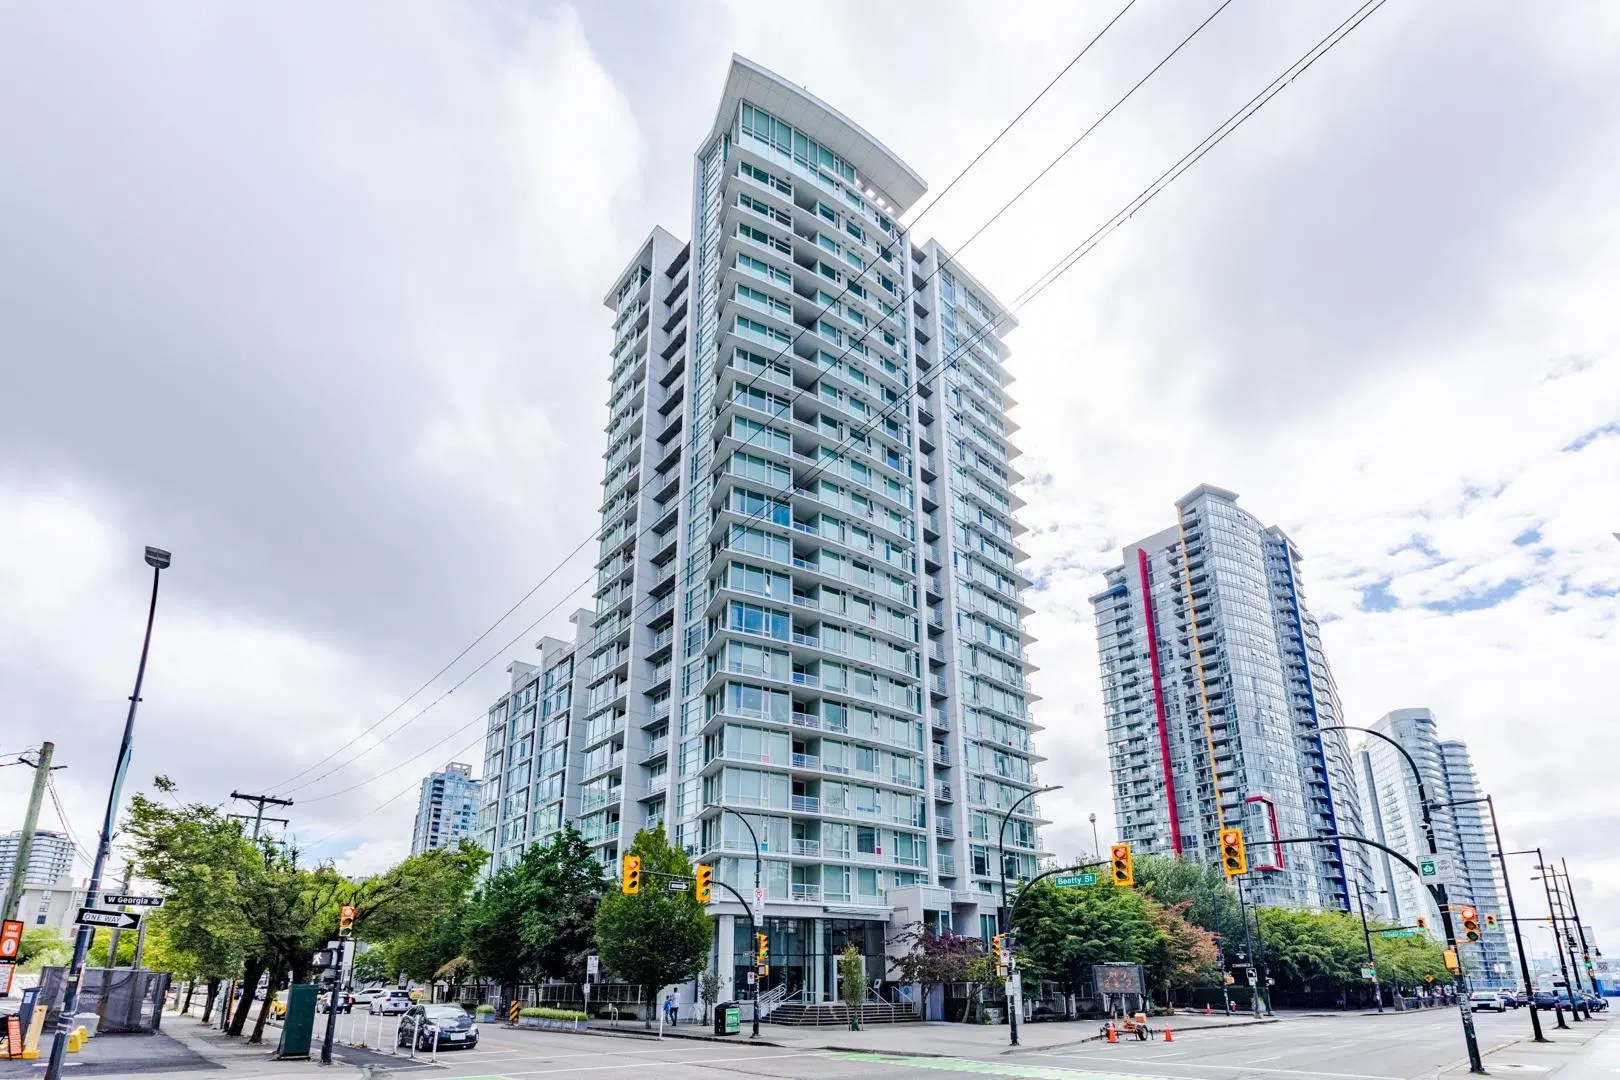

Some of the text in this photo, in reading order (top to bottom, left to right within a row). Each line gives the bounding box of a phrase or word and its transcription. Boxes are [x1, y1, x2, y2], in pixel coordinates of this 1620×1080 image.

[1058, 875, 1093, 884] Beatty St
[118, 897, 148, 905] Georgia
[84, 913, 102, 921] ONE
